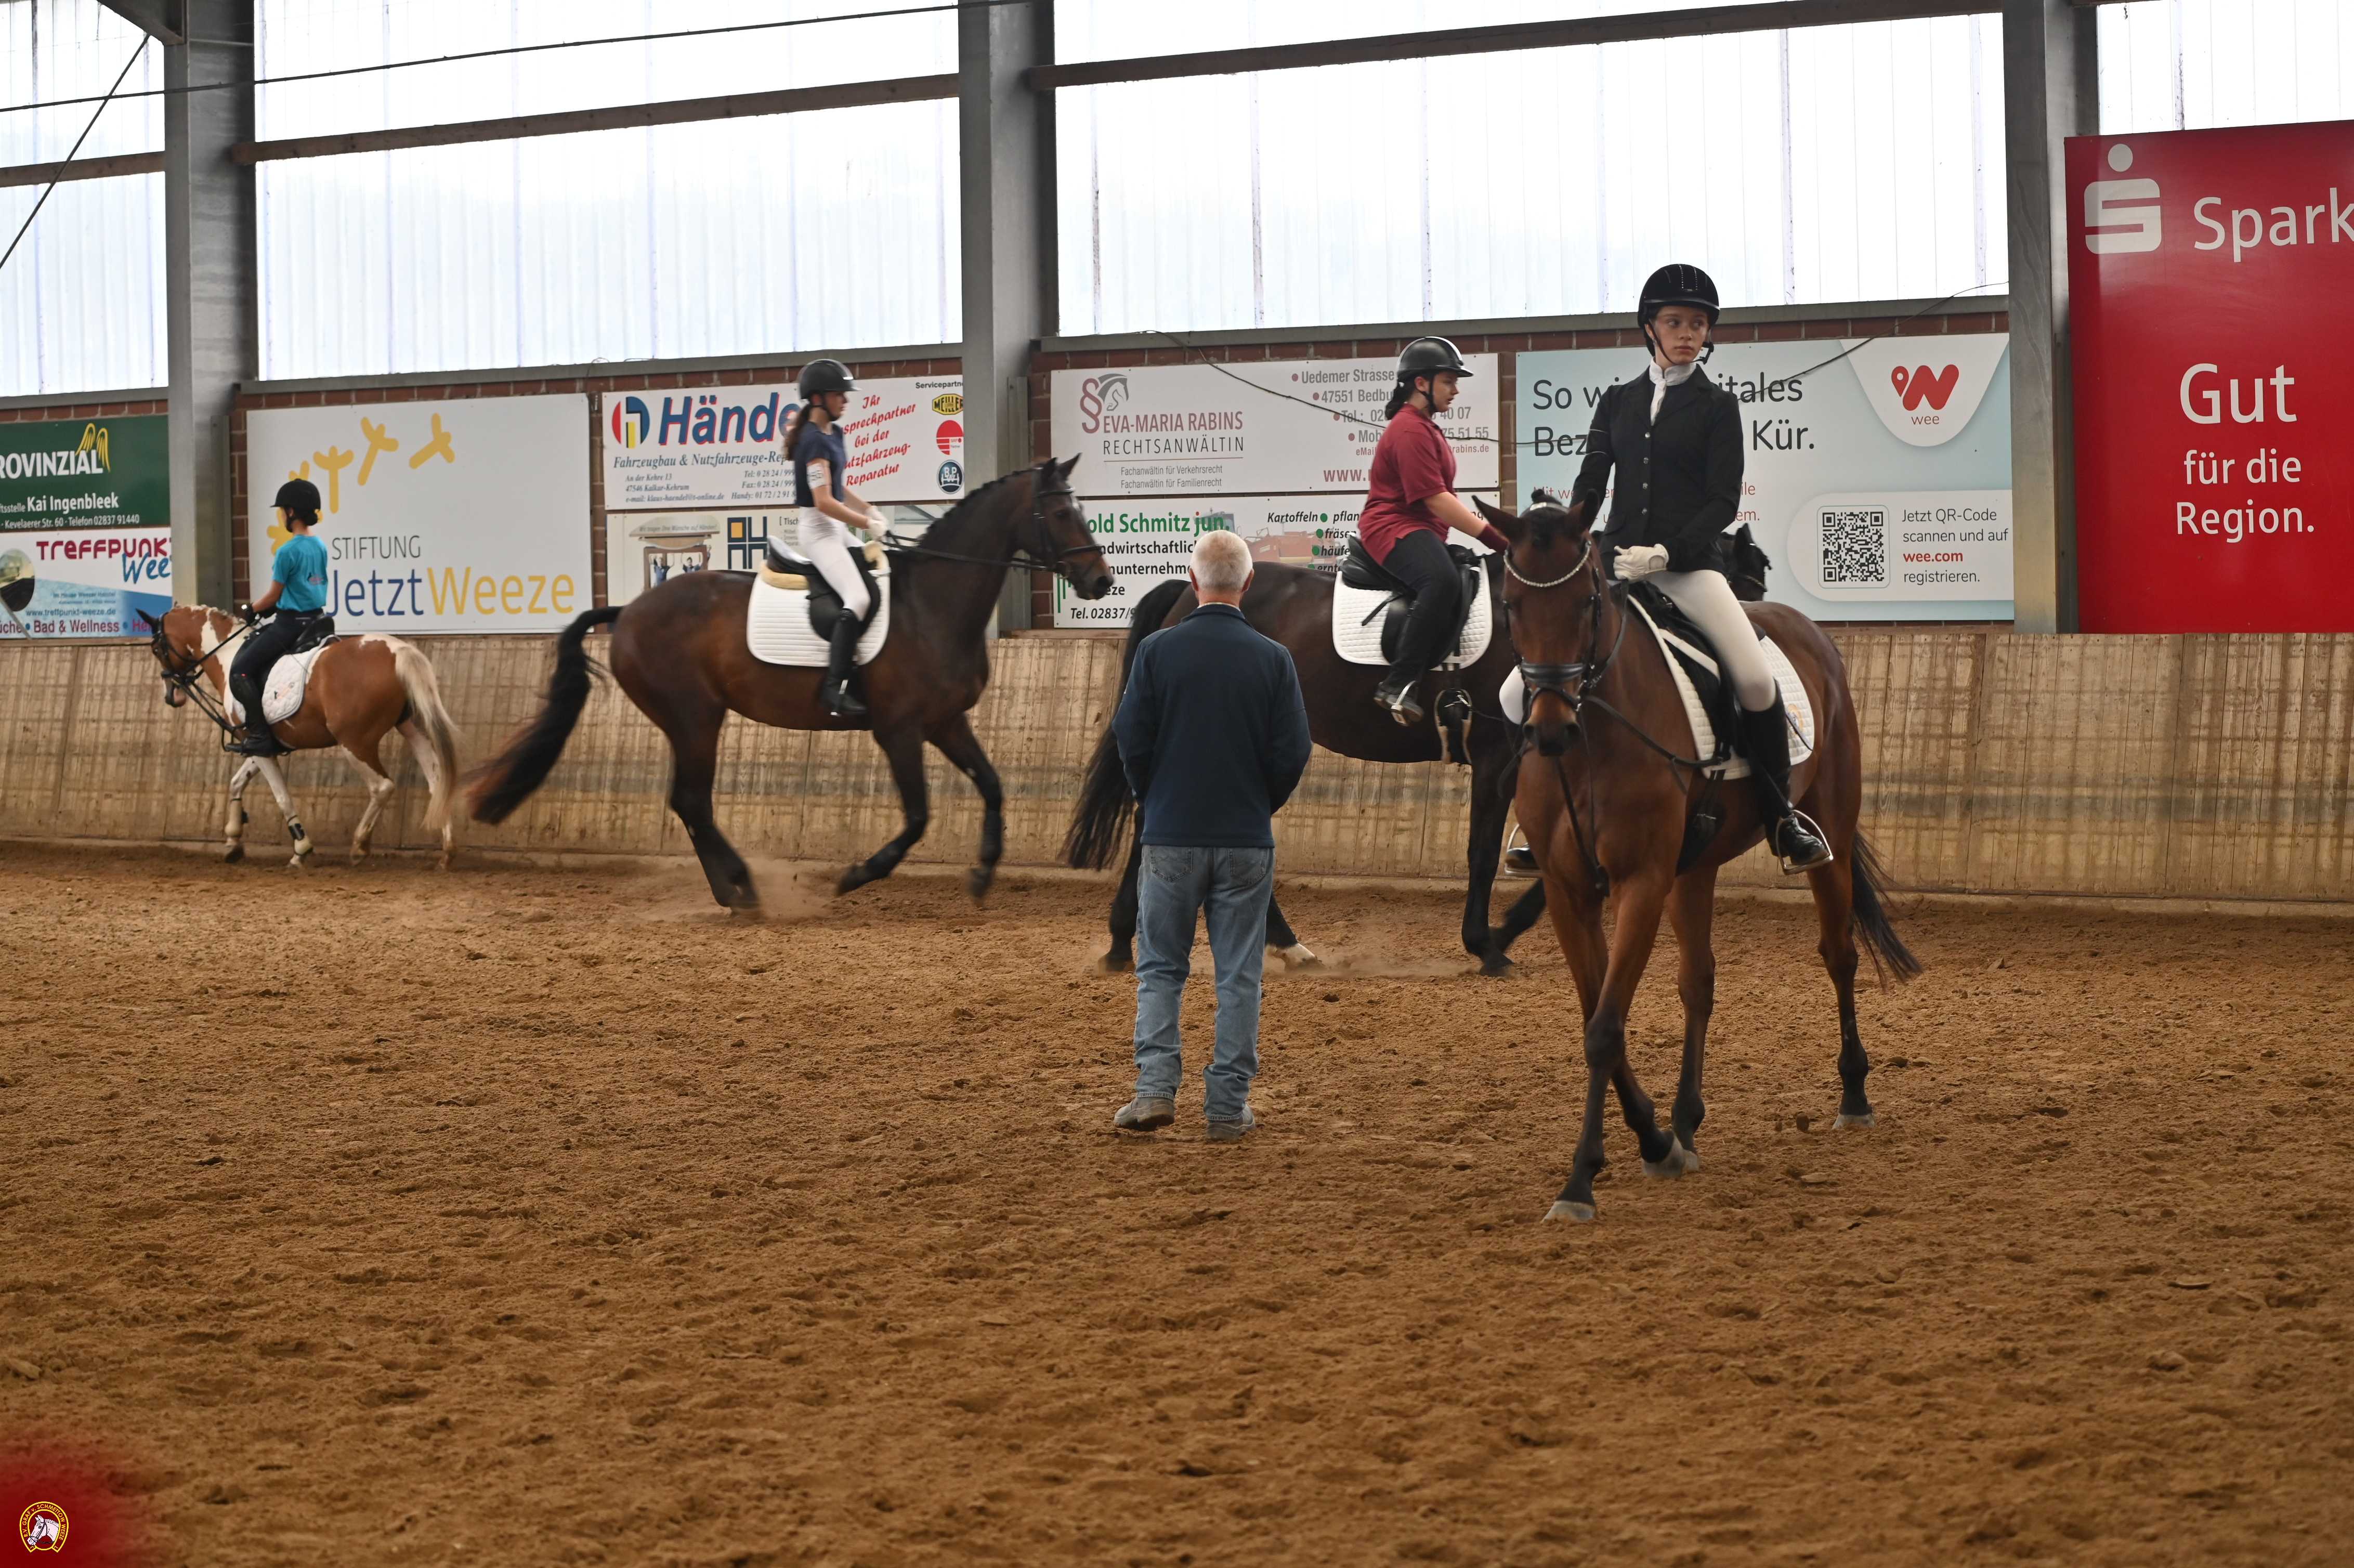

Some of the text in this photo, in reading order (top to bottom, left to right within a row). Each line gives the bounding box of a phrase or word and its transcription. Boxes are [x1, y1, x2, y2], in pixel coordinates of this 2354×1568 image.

[2193, 187, 2354, 263] Spark
[1301, 369, 1395, 384] Uedemer Strasse
[916, 381, 963, 389] Servicepartn
[1322, 390, 1353, 403] 47551
[1533, 380, 1572, 410] So
[2180, 363, 2297, 424] Gut
[862, 395, 880, 409] Ihr
[841, 404, 916, 435] sprechpartner
[1458, 407, 1471, 420] 07
[1911, 415, 1940, 425] wee
[1103, 411, 1243, 434] EVA-MARIA RABINS
[855, 429, 890, 448] bei der
[1458, 427, 1470, 440] 51
[1475, 427, 1488, 439] 55
[1753, 419, 1814, 451] Kür.
[1103, 434, 1244, 455] RECHTSANWÄLTIN
[613, 454, 676, 469] Fahrzeugbau
[679, 454, 688, 466] &
[2184, 448, 2301, 485] für die
[846, 464, 899, 487] Reparatur
[1121, 465, 1223, 476] Fachanwältin für Verkehrsrecht
[1121, 478, 1222, 489] Fachanwältin für Familienrecht
[27, 495, 46, 512] Kai
[50, 492, 119, 514] Ingenbleek
[731, 492, 753, 500] Handy:
[5, 514, 140, 529] Kevelaerer Str. 60 Telefon 02837 91440
[1267, 511, 1318, 522] Kartoffeln
[1902, 508, 1997, 522] Jetzt QR-Code
[2177, 499, 2314, 543] Region.
[1119, 512, 1190, 533] Schmitz
[1194, 512, 1230, 537] jun.
[1903, 528, 2009, 542] scannen und auf
[331, 535, 421, 560] STIFTUNG
[1903, 551, 1964, 562] wee.com
[122, 552, 172, 583] Wee
[1903, 570, 1980, 585] registrieren.
[1070, 607, 1088, 619] Tel.
[34, 620, 55, 633] Bad
[59, 620, 66, 633] &
[70, 619, 120, 633] Wellness
